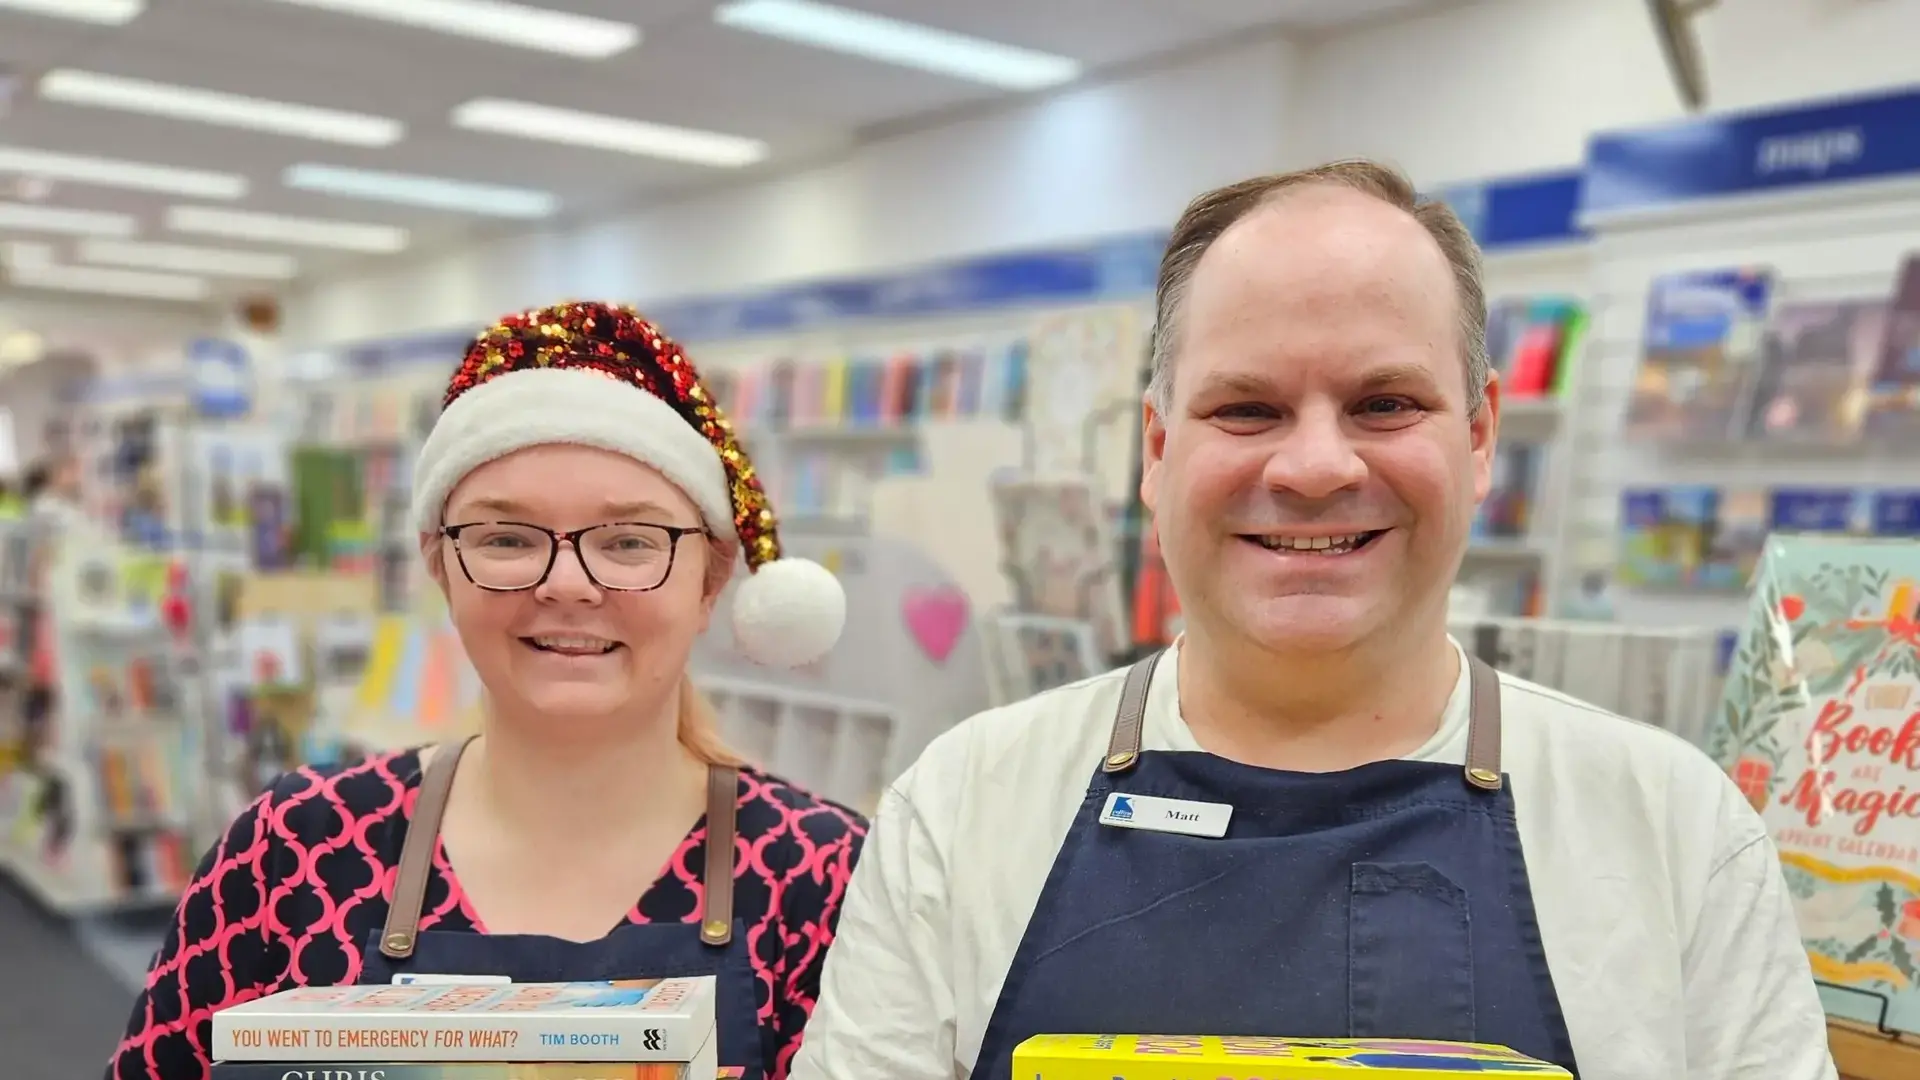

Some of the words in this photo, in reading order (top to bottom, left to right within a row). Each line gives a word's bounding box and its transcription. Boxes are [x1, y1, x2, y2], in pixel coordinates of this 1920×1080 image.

[1165, 810, 1200, 821] Matt
[232, 1029, 262, 1047] YOU
[267, 1029, 310, 1047] WENT
[315, 1029, 332, 1047] TO
[338, 1029, 428, 1047] EMERGENCY
[435, 1030, 463, 1047] FOR
[469, 1030, 518, 1048] WHAT?
[540, 1034, 565, 1045] TIM
[570, 1034, 619, 1045] BOOTH
